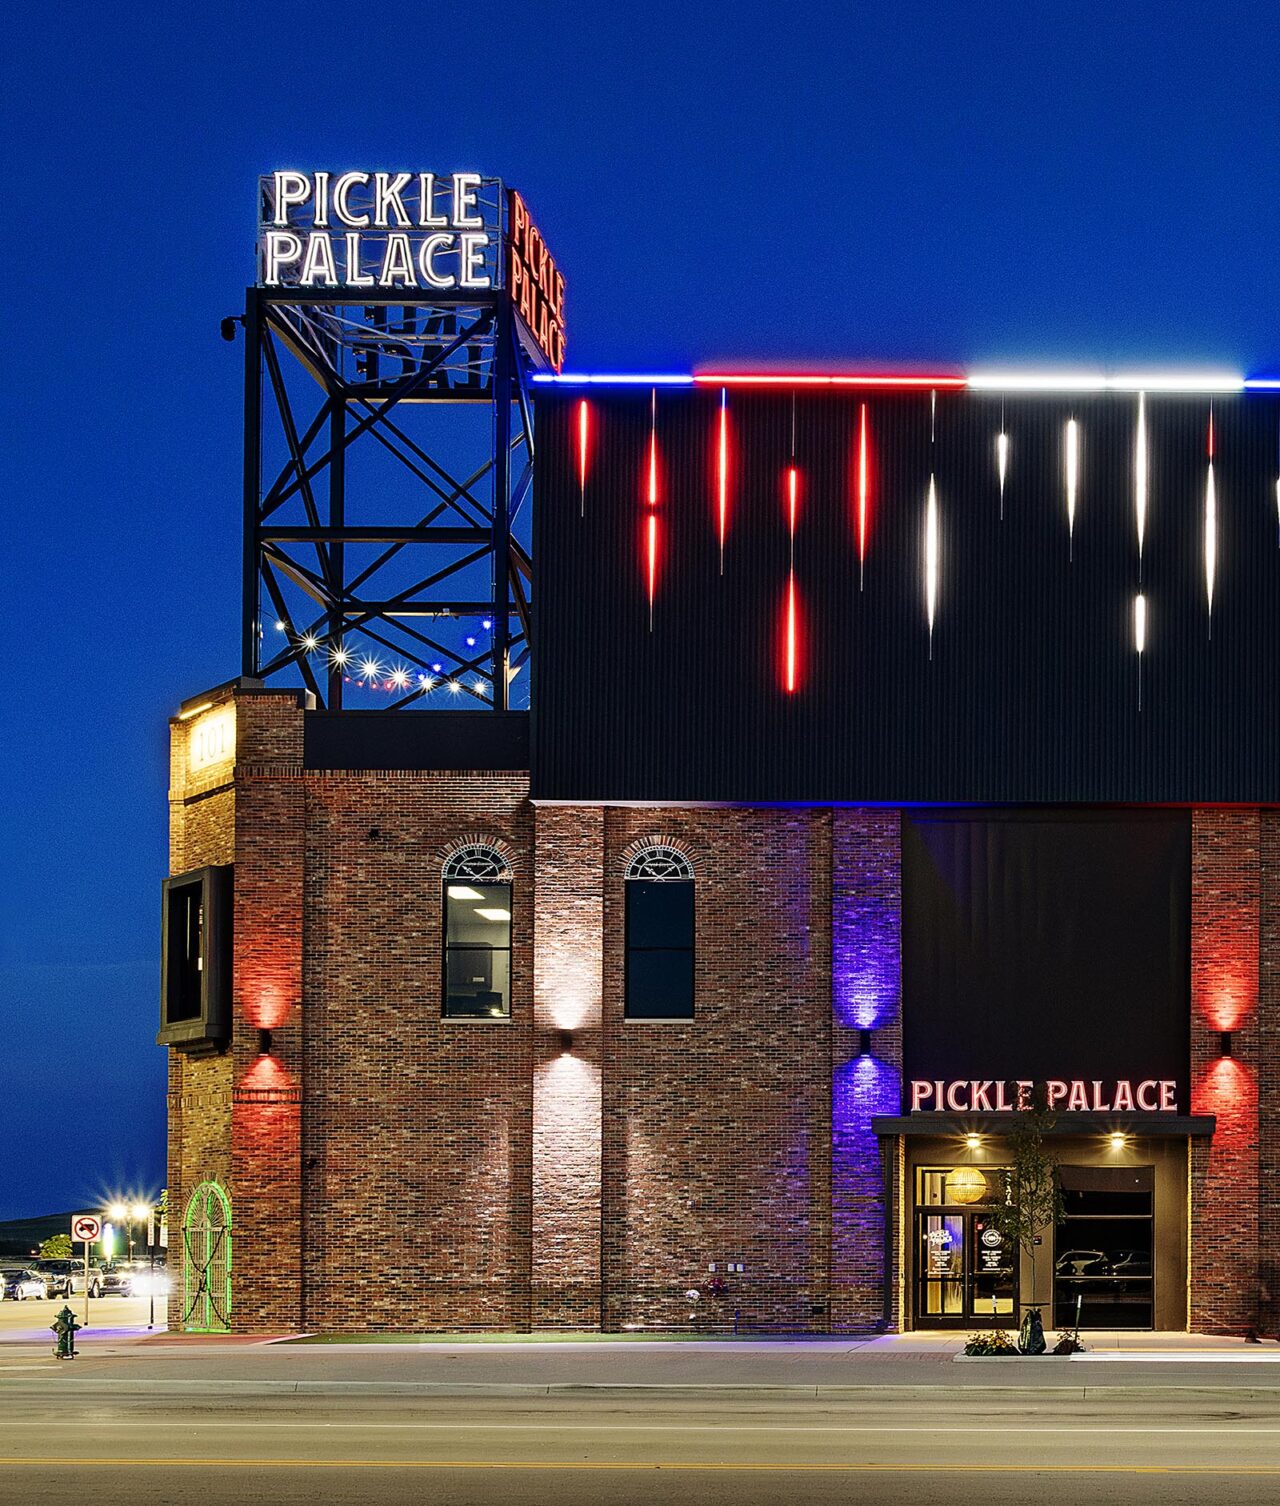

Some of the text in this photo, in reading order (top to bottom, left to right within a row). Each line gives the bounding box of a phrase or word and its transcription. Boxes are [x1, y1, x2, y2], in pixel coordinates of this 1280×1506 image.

[273, 171, 483, 227] PICKLE
[265, 232, 491, 288] PALACE
[514, 191, 566, 328] PICKLE
[511, 246, 566, 376] PALACE
[200, 724, 225, 762] 101
[911, 1080, 1178, 1112] PICKLE PALACE
